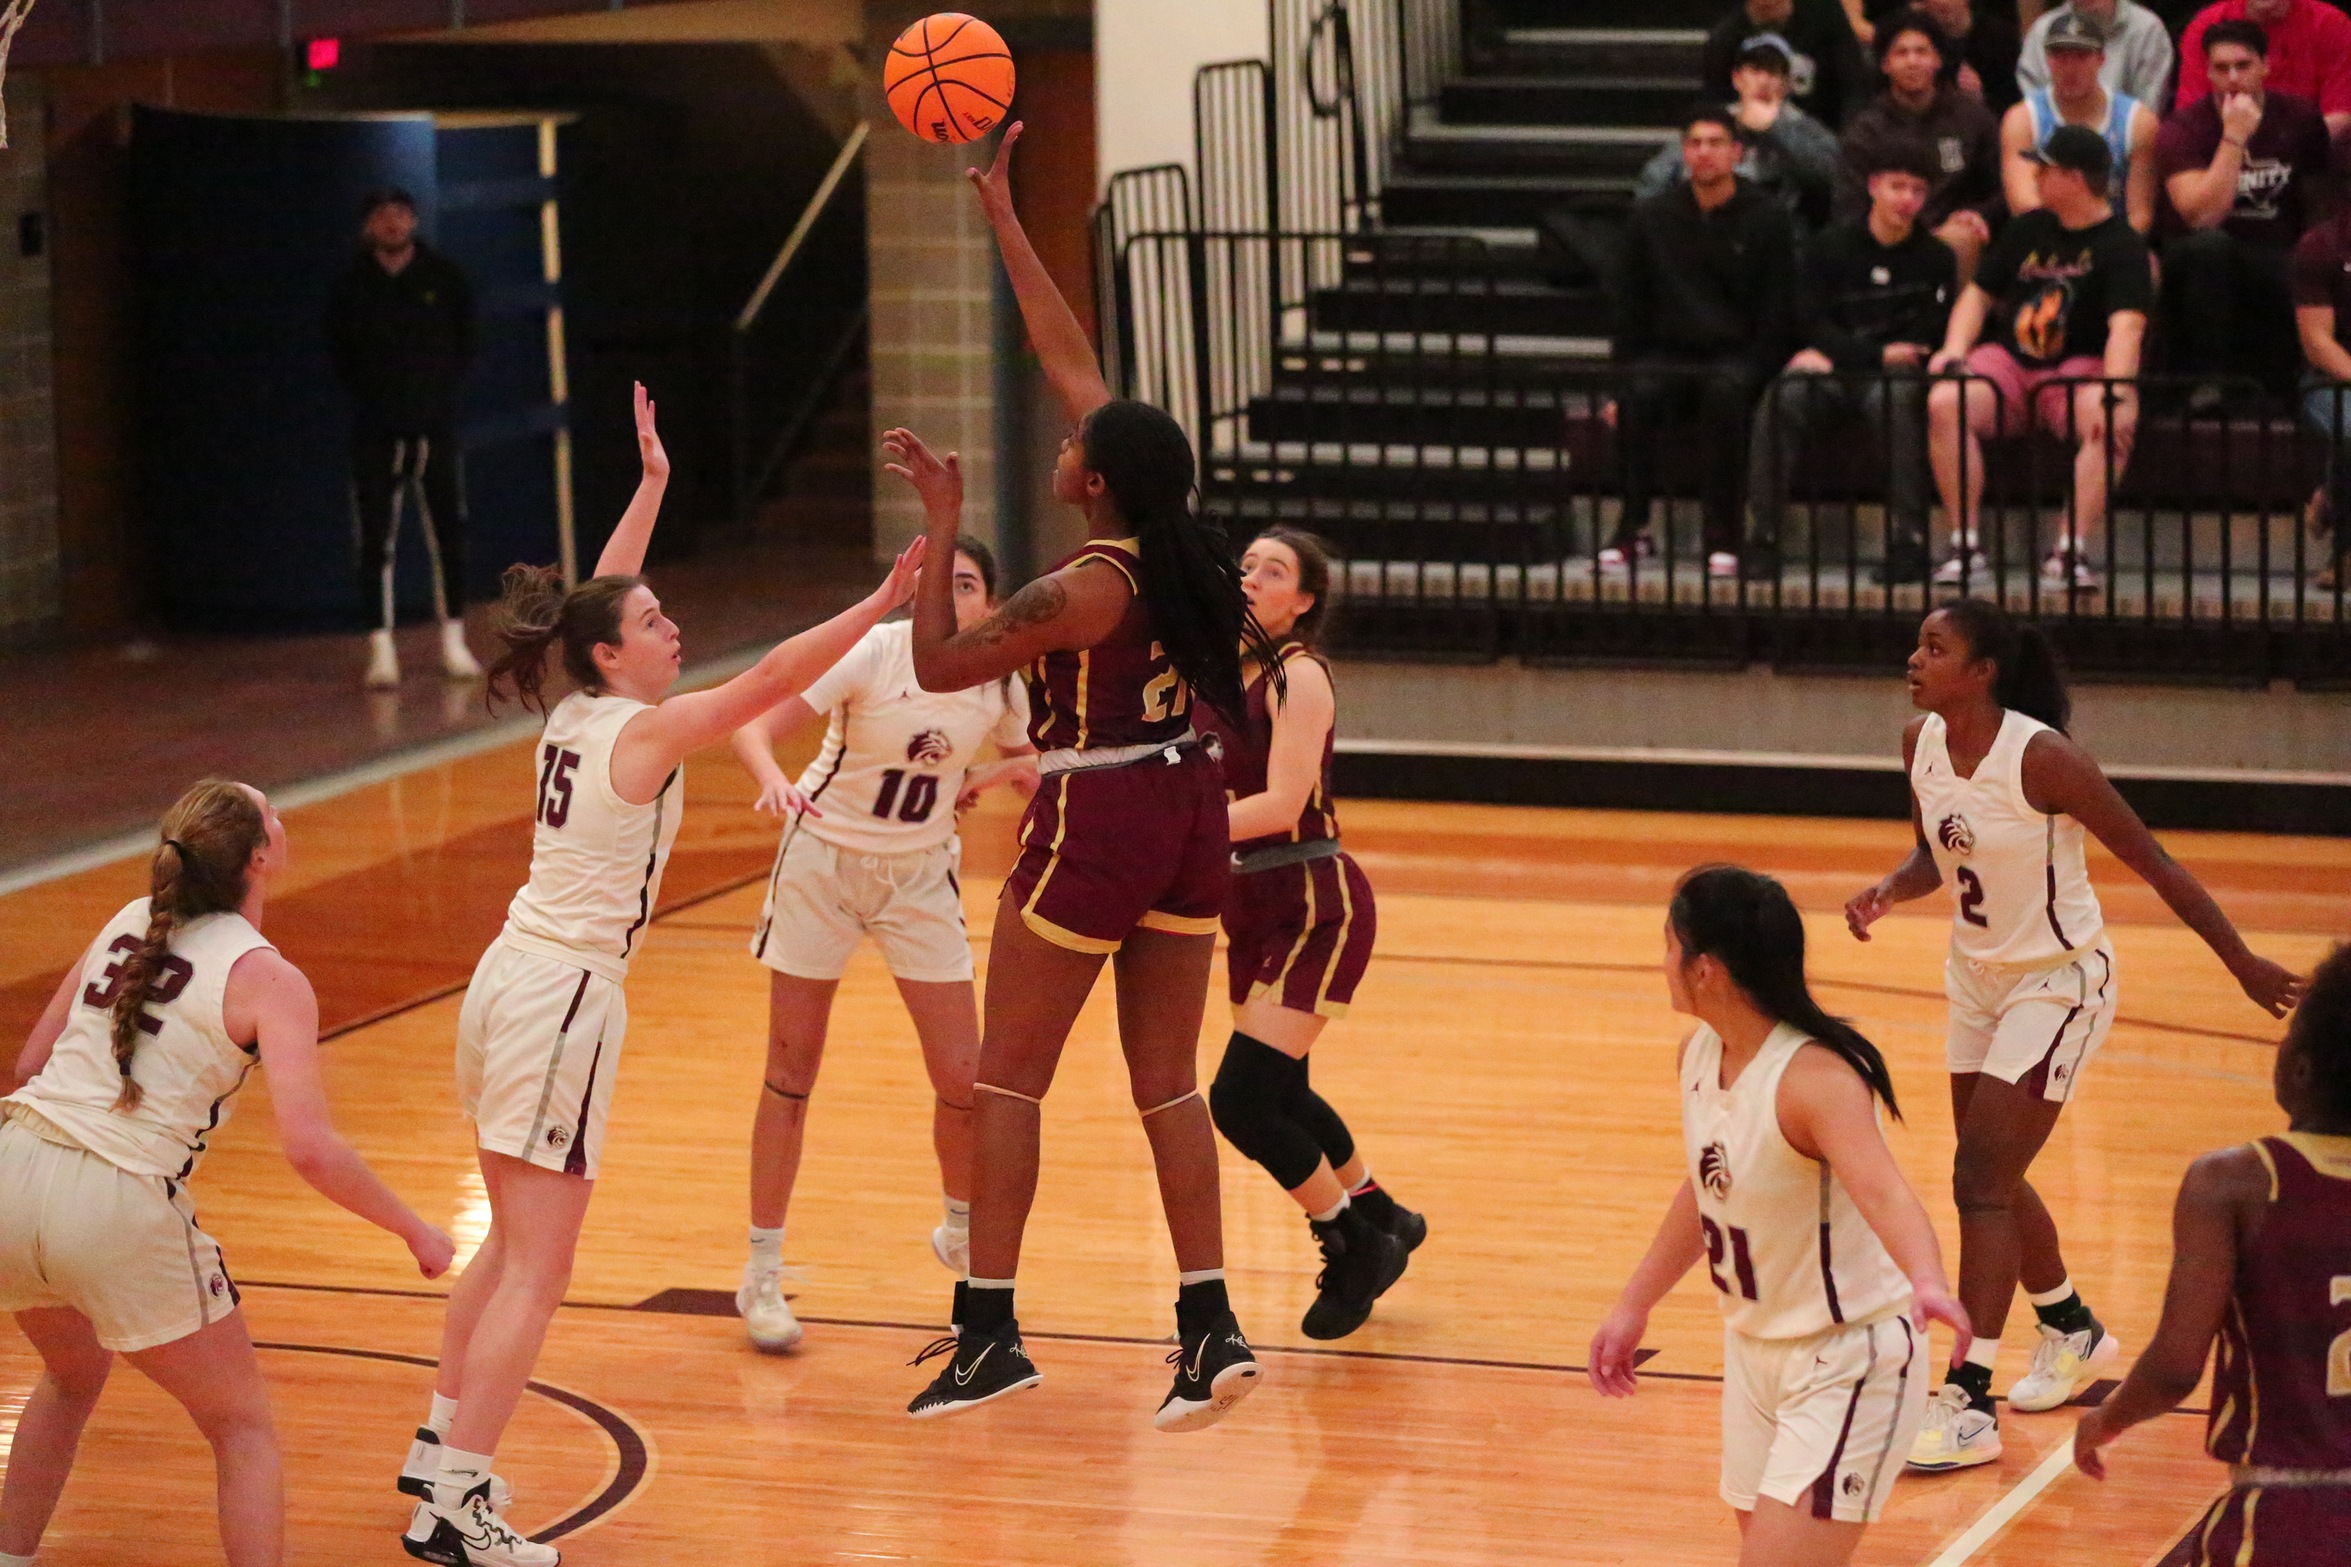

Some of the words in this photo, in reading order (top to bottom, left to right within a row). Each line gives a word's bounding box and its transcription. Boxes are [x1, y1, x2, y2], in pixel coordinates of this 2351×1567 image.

[536, 743, 581, 829] 15
[872, 768, 939, 823] 10
[1956, 865, 1988, 928] 2
[82, 933, 194, 1038] 32
[1700, 1212, 1759, 1303] 21
